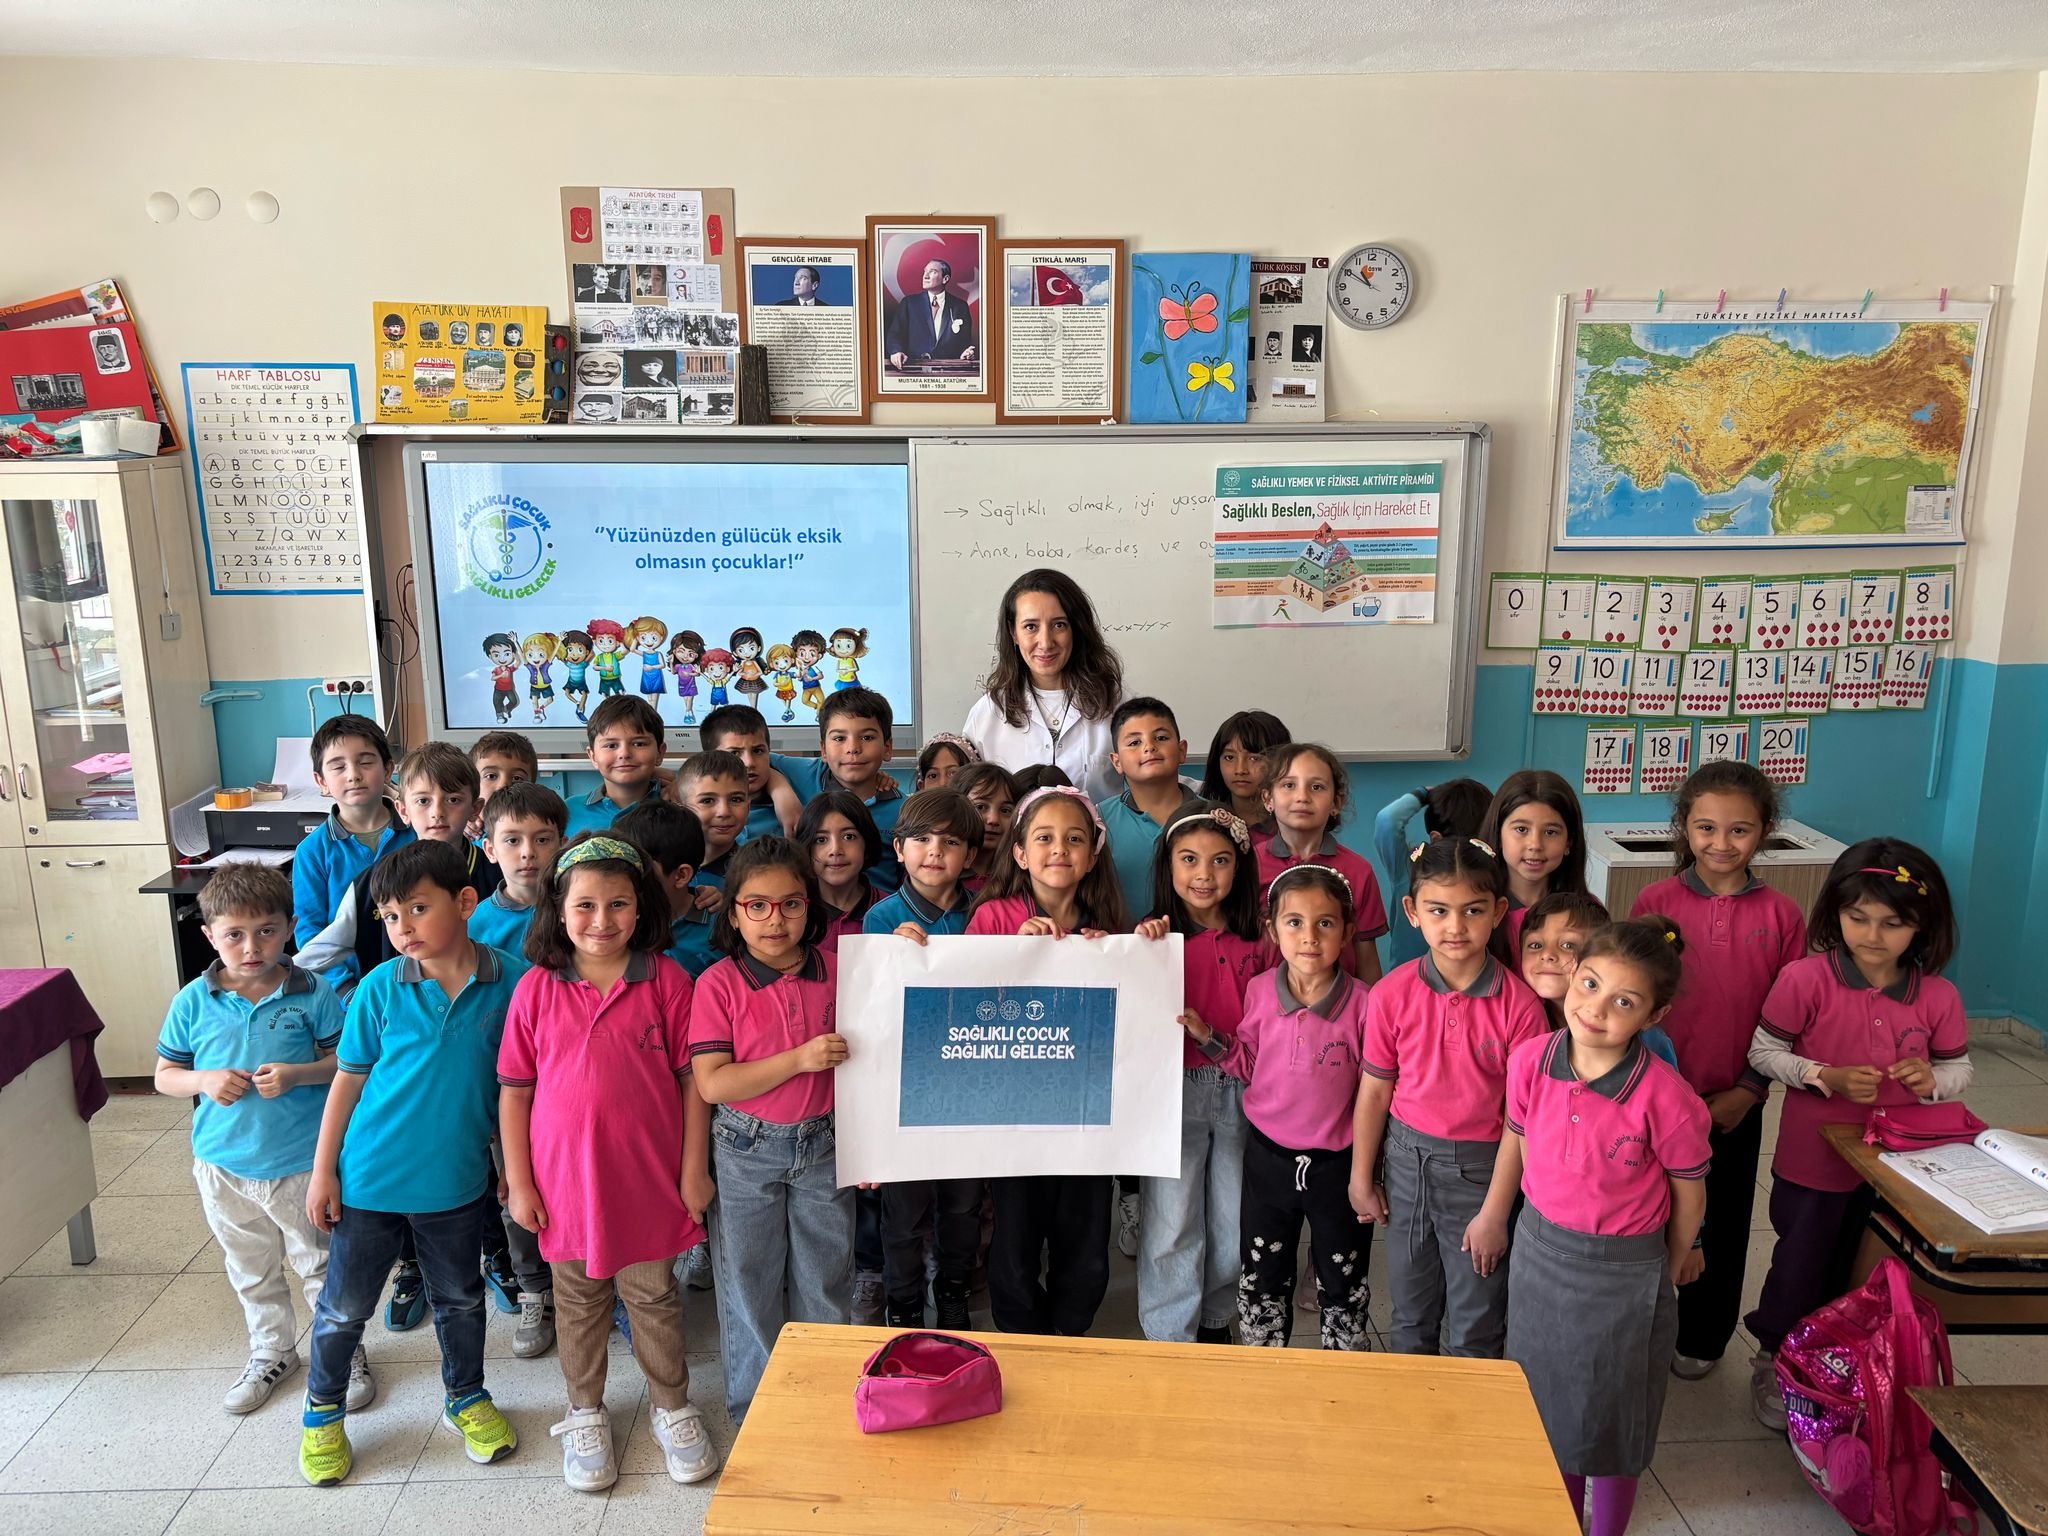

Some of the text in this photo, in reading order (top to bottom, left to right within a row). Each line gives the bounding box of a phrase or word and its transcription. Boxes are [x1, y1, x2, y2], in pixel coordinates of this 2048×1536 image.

[771, 255, 806, 264] GENÇLİĞE
[1276, 263, 1301, 272] KÖŞESİ
[1344, 268, 1352, 276] 10
[1392, 268, 1399, 277] 2
[1395, 282, 1403, 290] 3
[1391, 297, 1398, 305] 4
[476, 306, 512, 318] HAYATI
[1353, 308, 1360, 316] 7
[1366, 312, 1373, 320] 6
[1695, 311, 1864, 320] TÜRKİYE FİZİKİ HARİTASI
[216, 370, 321, 381] HARF TABLOSU
[215, 392, 222, 404] b
[246, 398, 252, 407] ç
[260, 393, 267, 404] d
[291, 393, 297, 404] f
[306, 398, 313, 409] g
[322, 395, 328, 409] ğ
[337, 393, 344, 405] h
[209, 459, 347, 474] A B C Ç D E F
[1251, 472, 1434, 488] SAĞLIKLI YEMEK VE FİZİKSEL AKTİVİTE PİRAMİDİ
[512, 496, 552, 532] ÇOCUK
[978, 499, 1047, 526] Sağlıklı
[1068, 495, 1123, 514] olmak,
[1134, 492, 1156, 517] iyi
[1222, 499, 1431, 522] Sağlıklı Beslen, Sağlık İçin Hareket Et
[722, 526, 792, 547] gülücük
[797, 527, 842, 545] eksik
[969, 541, 1018, 560] Anne,
[1026, 542, 1072, 559] baba,
[1084, 537, 1139, 559] kardeş
[1161, 540, 1180, 553] ve
[222, 554, 362, 566] 1 2 3 4 5 6 7 8 9 0
[635, 553, 706, 571] olmasın
[465, 558, 556, 599] SAĞLIKLI GELECEK
[1508, 588, 1524, 610] 0
[1562, 589, 1569, 612] 1
[1606, 591, 1623, 613] 2
[1660, 592, 1673, 614] 3
[1711, 591, 1727, 613] 4
[1764, 591, 1780, 613] 5
[1812, 589, 1826, 611] 6
[1862, 585, 1877, 607] 7
[1917, 582, 1930, 604] 8
[1548, 655, 1562, 676] 9
[1592, 657, 1615, 679] 10
[1646, 658, 1660, 680] 11
[1692, 659, 1716, 680] 12
[1746, 657, 1768, 679] 13
[1792, 656, 1816, 677] 14
[1844, 652, 1869, 673] 15
[1896, 650, 1916, 671] 16
[1594, 737, 1617, 759] 17
[1650, 736, 1671, 758] 18
[1708, 733, 1729, 754] 19
[1763, 728, 1793, 750] 20
[948, 1024, 1070, 1044] SAĞLIKLI ÇOCUK
[941, 1042, 1076, 1060] SAĞLIKLI GELECEK
[1824, 1351, 1850, 1377] LOL
[1790, 1396, 1814, 1416] DIVA
